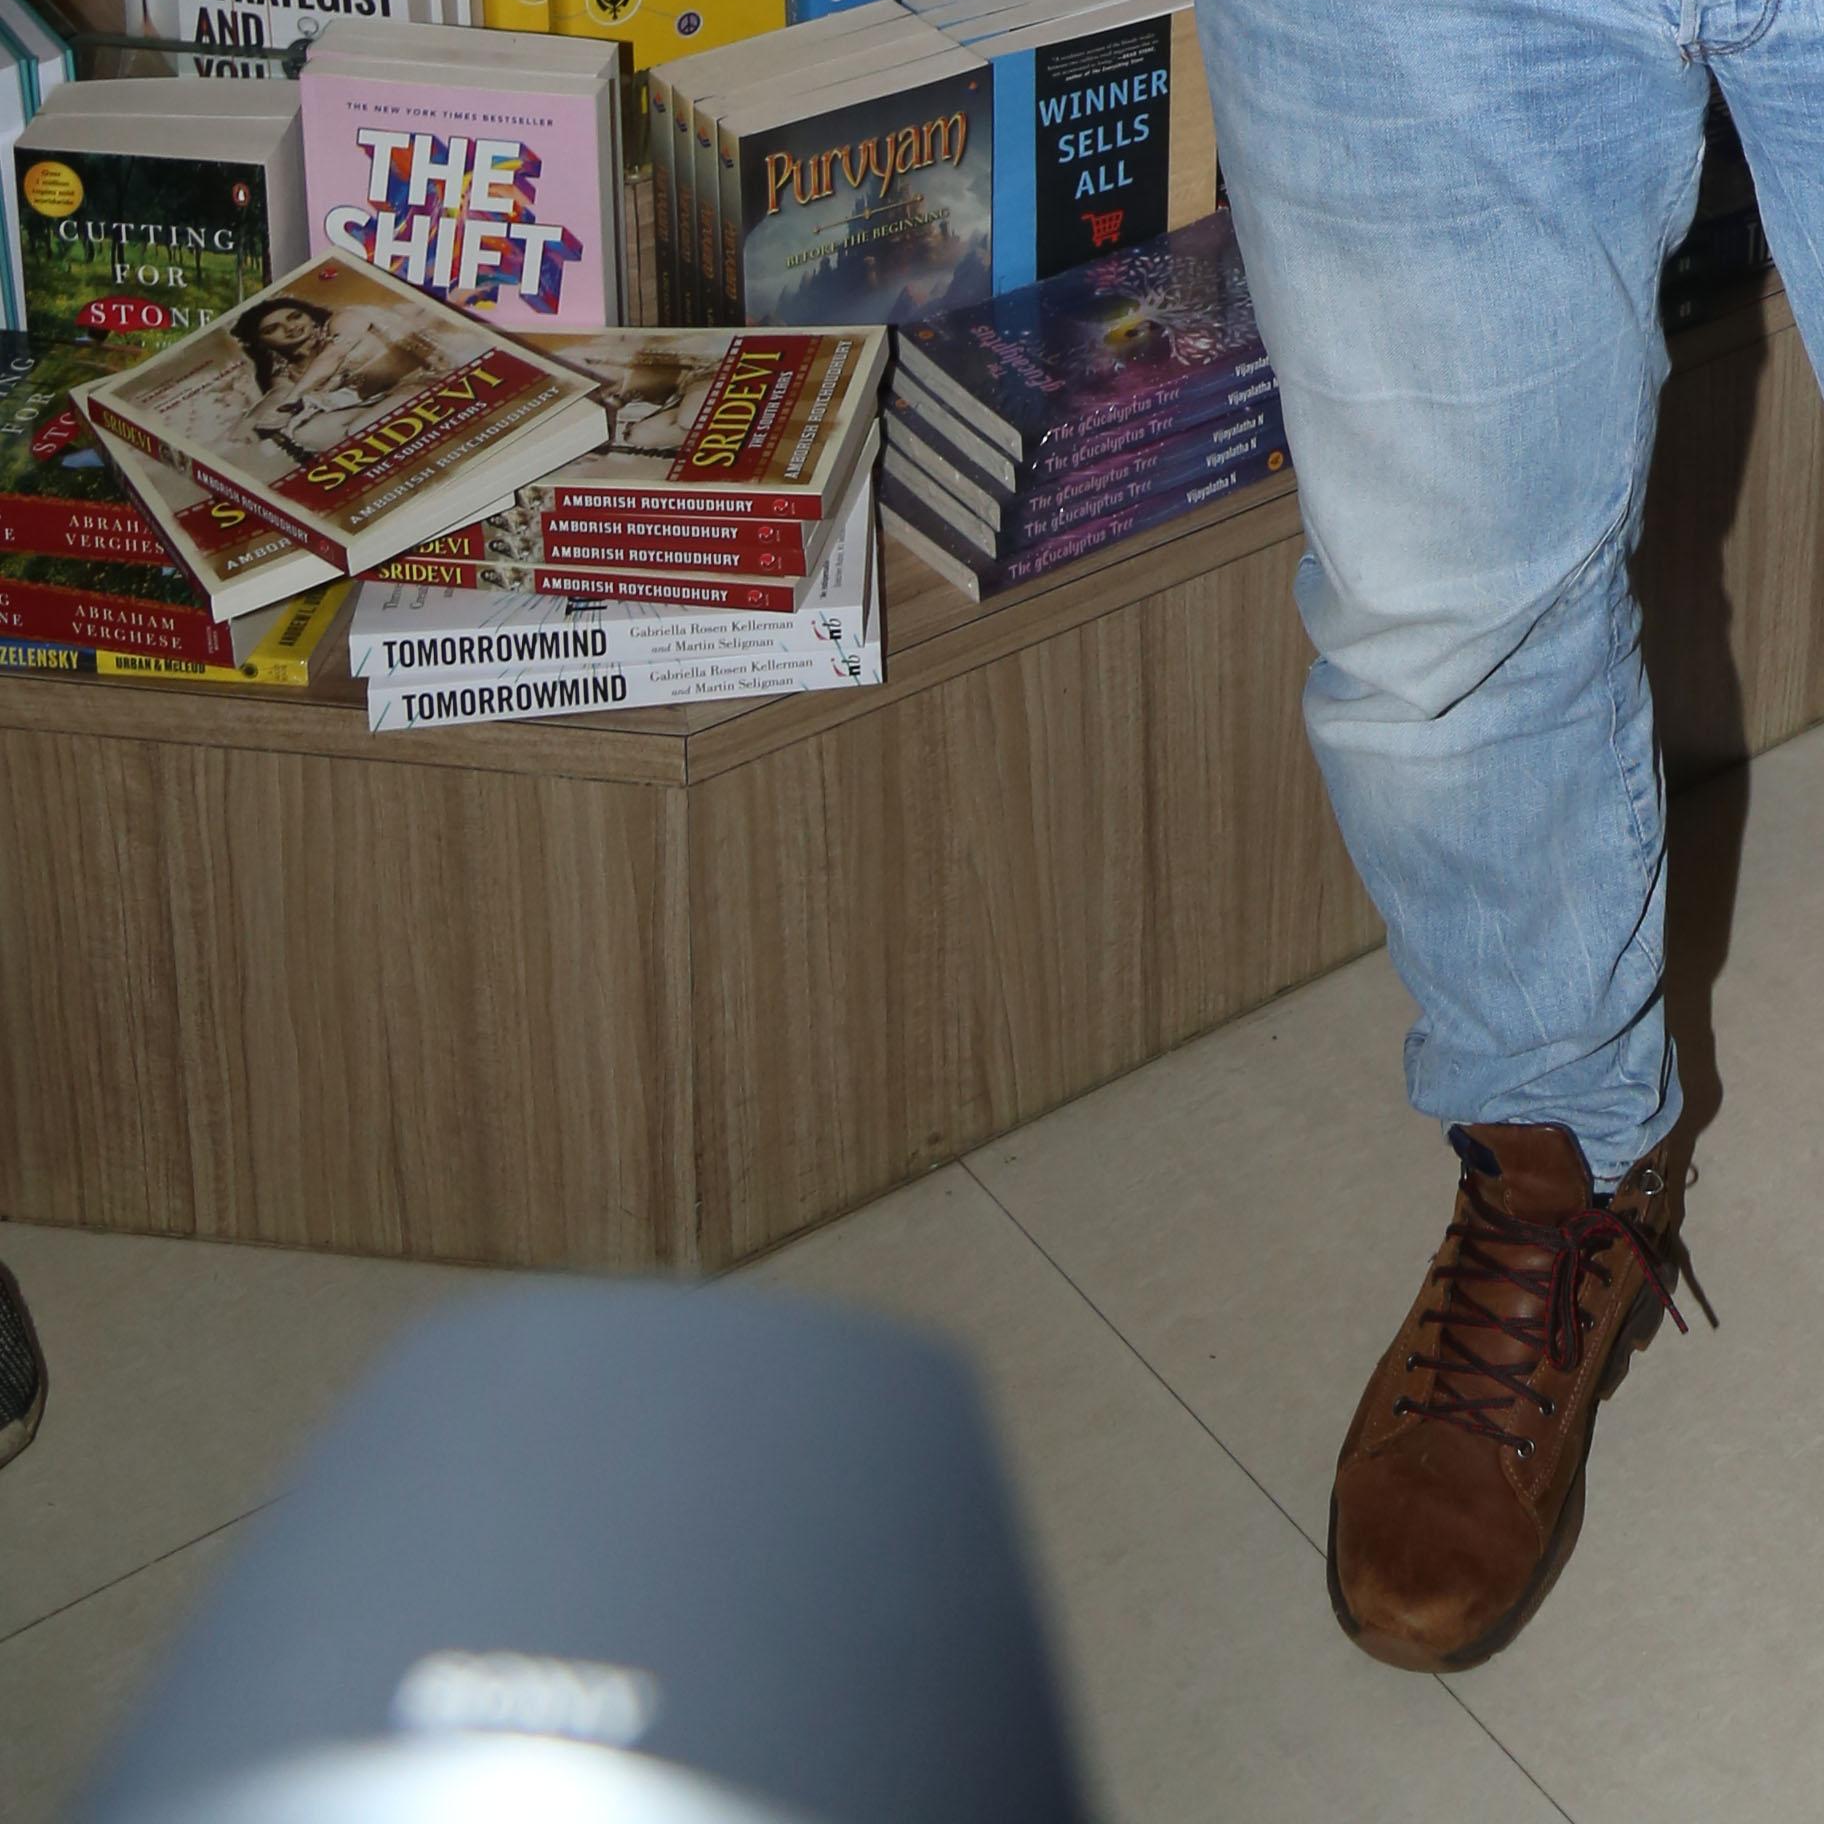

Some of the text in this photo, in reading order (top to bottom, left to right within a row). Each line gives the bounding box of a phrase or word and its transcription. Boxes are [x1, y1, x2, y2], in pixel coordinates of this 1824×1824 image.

[194, 7, 265, 48] AND
[346, 102, 555, 127] THE NEW YORK TIMES BESTSELLER
[1038, 68, 1169, 129] WINNER
[1058, 112, 1150, 165] SELLS
[356, 127, 535, 215] THE
[764, 110, 968, 215] Purvyam
[1074, 161, 1134, 201] ALL
[59, 219, 236, 252] CUTTING
[325, 204, 575, 302] SHIFT
[785, 207, 951, 270] BEFORE THE BEGINNING
[115, 263, 189, 288] FOR
[90, 302, 214, 331] STONE
[103, 411, 154, 454] SRIDEVI
[307, 366, 503, 492] SRIDEVI
[365, 400, 488, 480] THE SOUTH YEARS
[349, 386, 560, 525] AMBORISH ROYCHOUDHURY
[562, 494, 753, 513] AMBORISH ROYCHOUDHURY
[1008, 559, 1033, 579] The
[1110, 516, 1134, 536] Tree
[1186, 477, 1229, 504] Vijayalatha
[1229, 471, 1237, 485] N
[71, 621, 183, 650] VERGHESE
[74, 603, 176, 631] ABRAHAM
[629, 618, 794, 640] Gabriella Rosen Kellerman
[381, 628, 607, 669] TOMORROWMIND
[651, 636, 774, 654] and Martin Seligman
